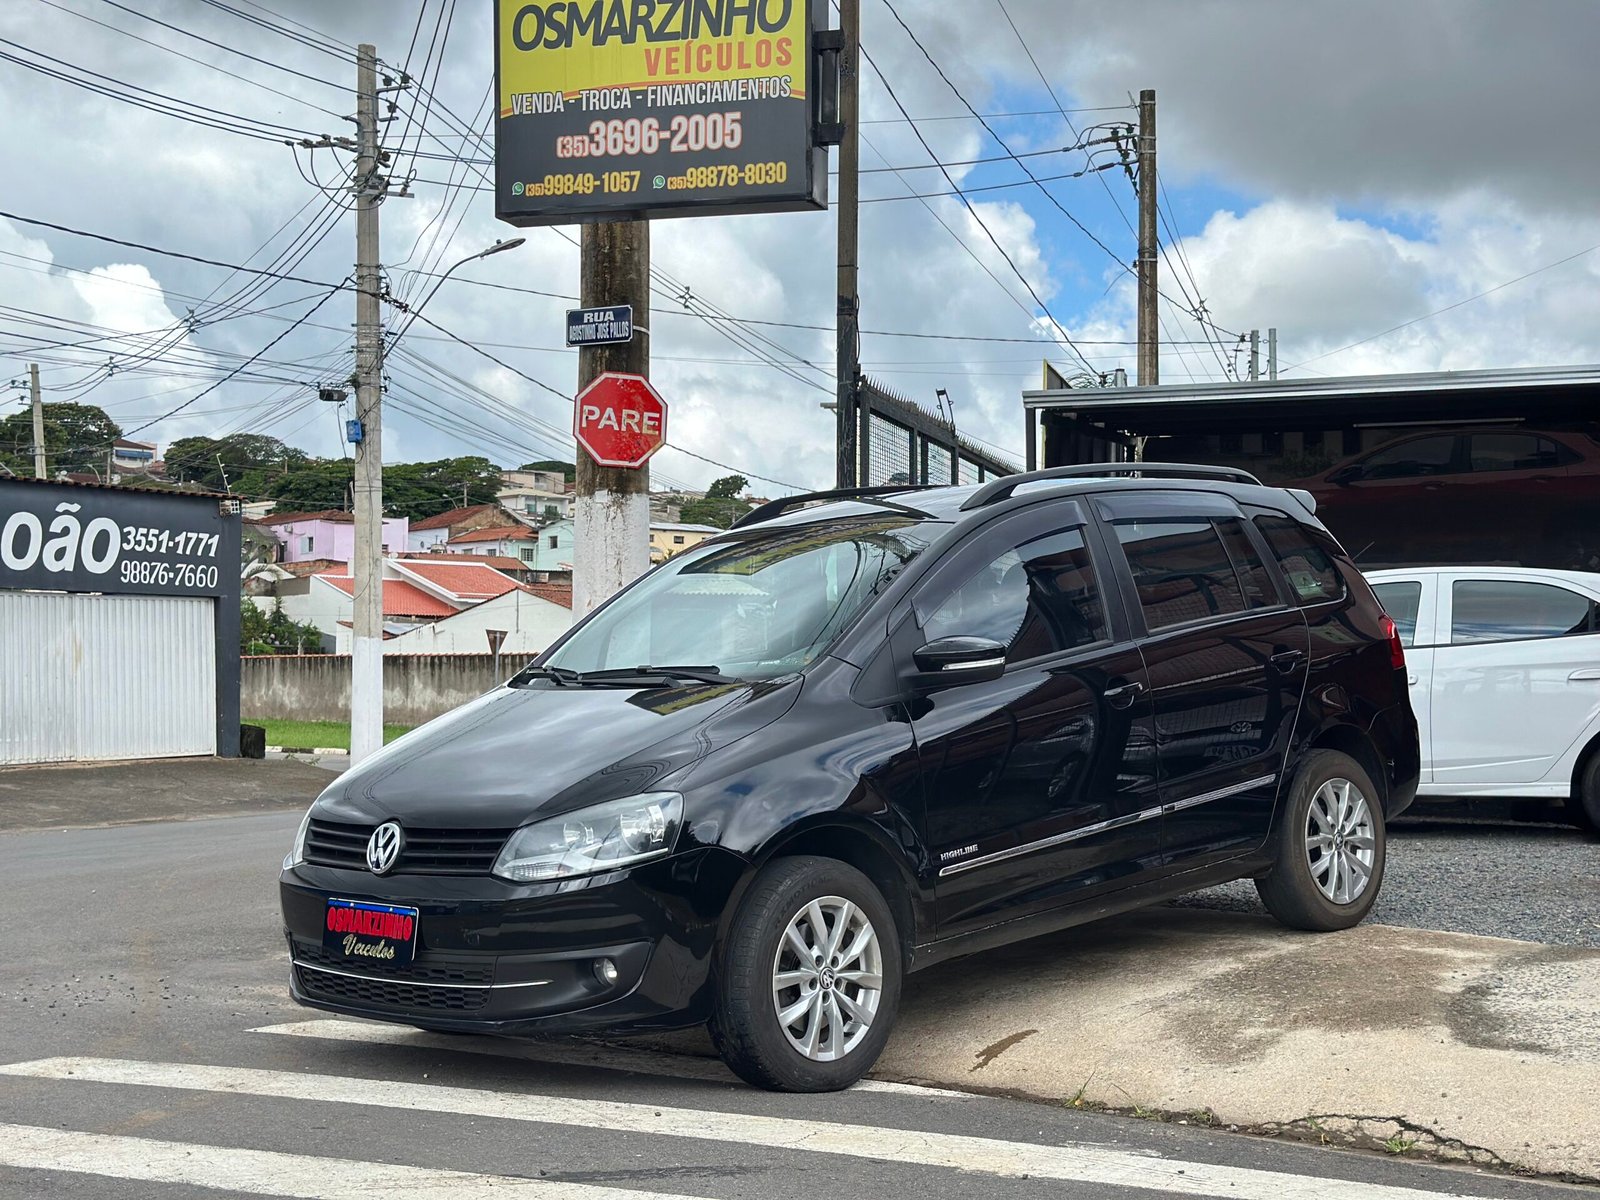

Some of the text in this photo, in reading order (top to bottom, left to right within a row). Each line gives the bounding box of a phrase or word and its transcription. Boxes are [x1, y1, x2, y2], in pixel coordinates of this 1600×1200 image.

[513, 0, 792, 51] OSMARZINHO
[644, 37, 793, 76] VEÍCULOS
[511, 91, 564, 115] VENDA
[578, 88, 632, 111] TROCA
[647, 76, 791, 108] FINANCIAMENTOS
[556, 112, 742, 158] (35)3696-2005
[583, 311, 615, 323] RUA
[581, 405, 660, 435] PARE
[940, 844, 979, 861] HIGHLINE
[327, 906, 413, 941] OSMARZINHO
